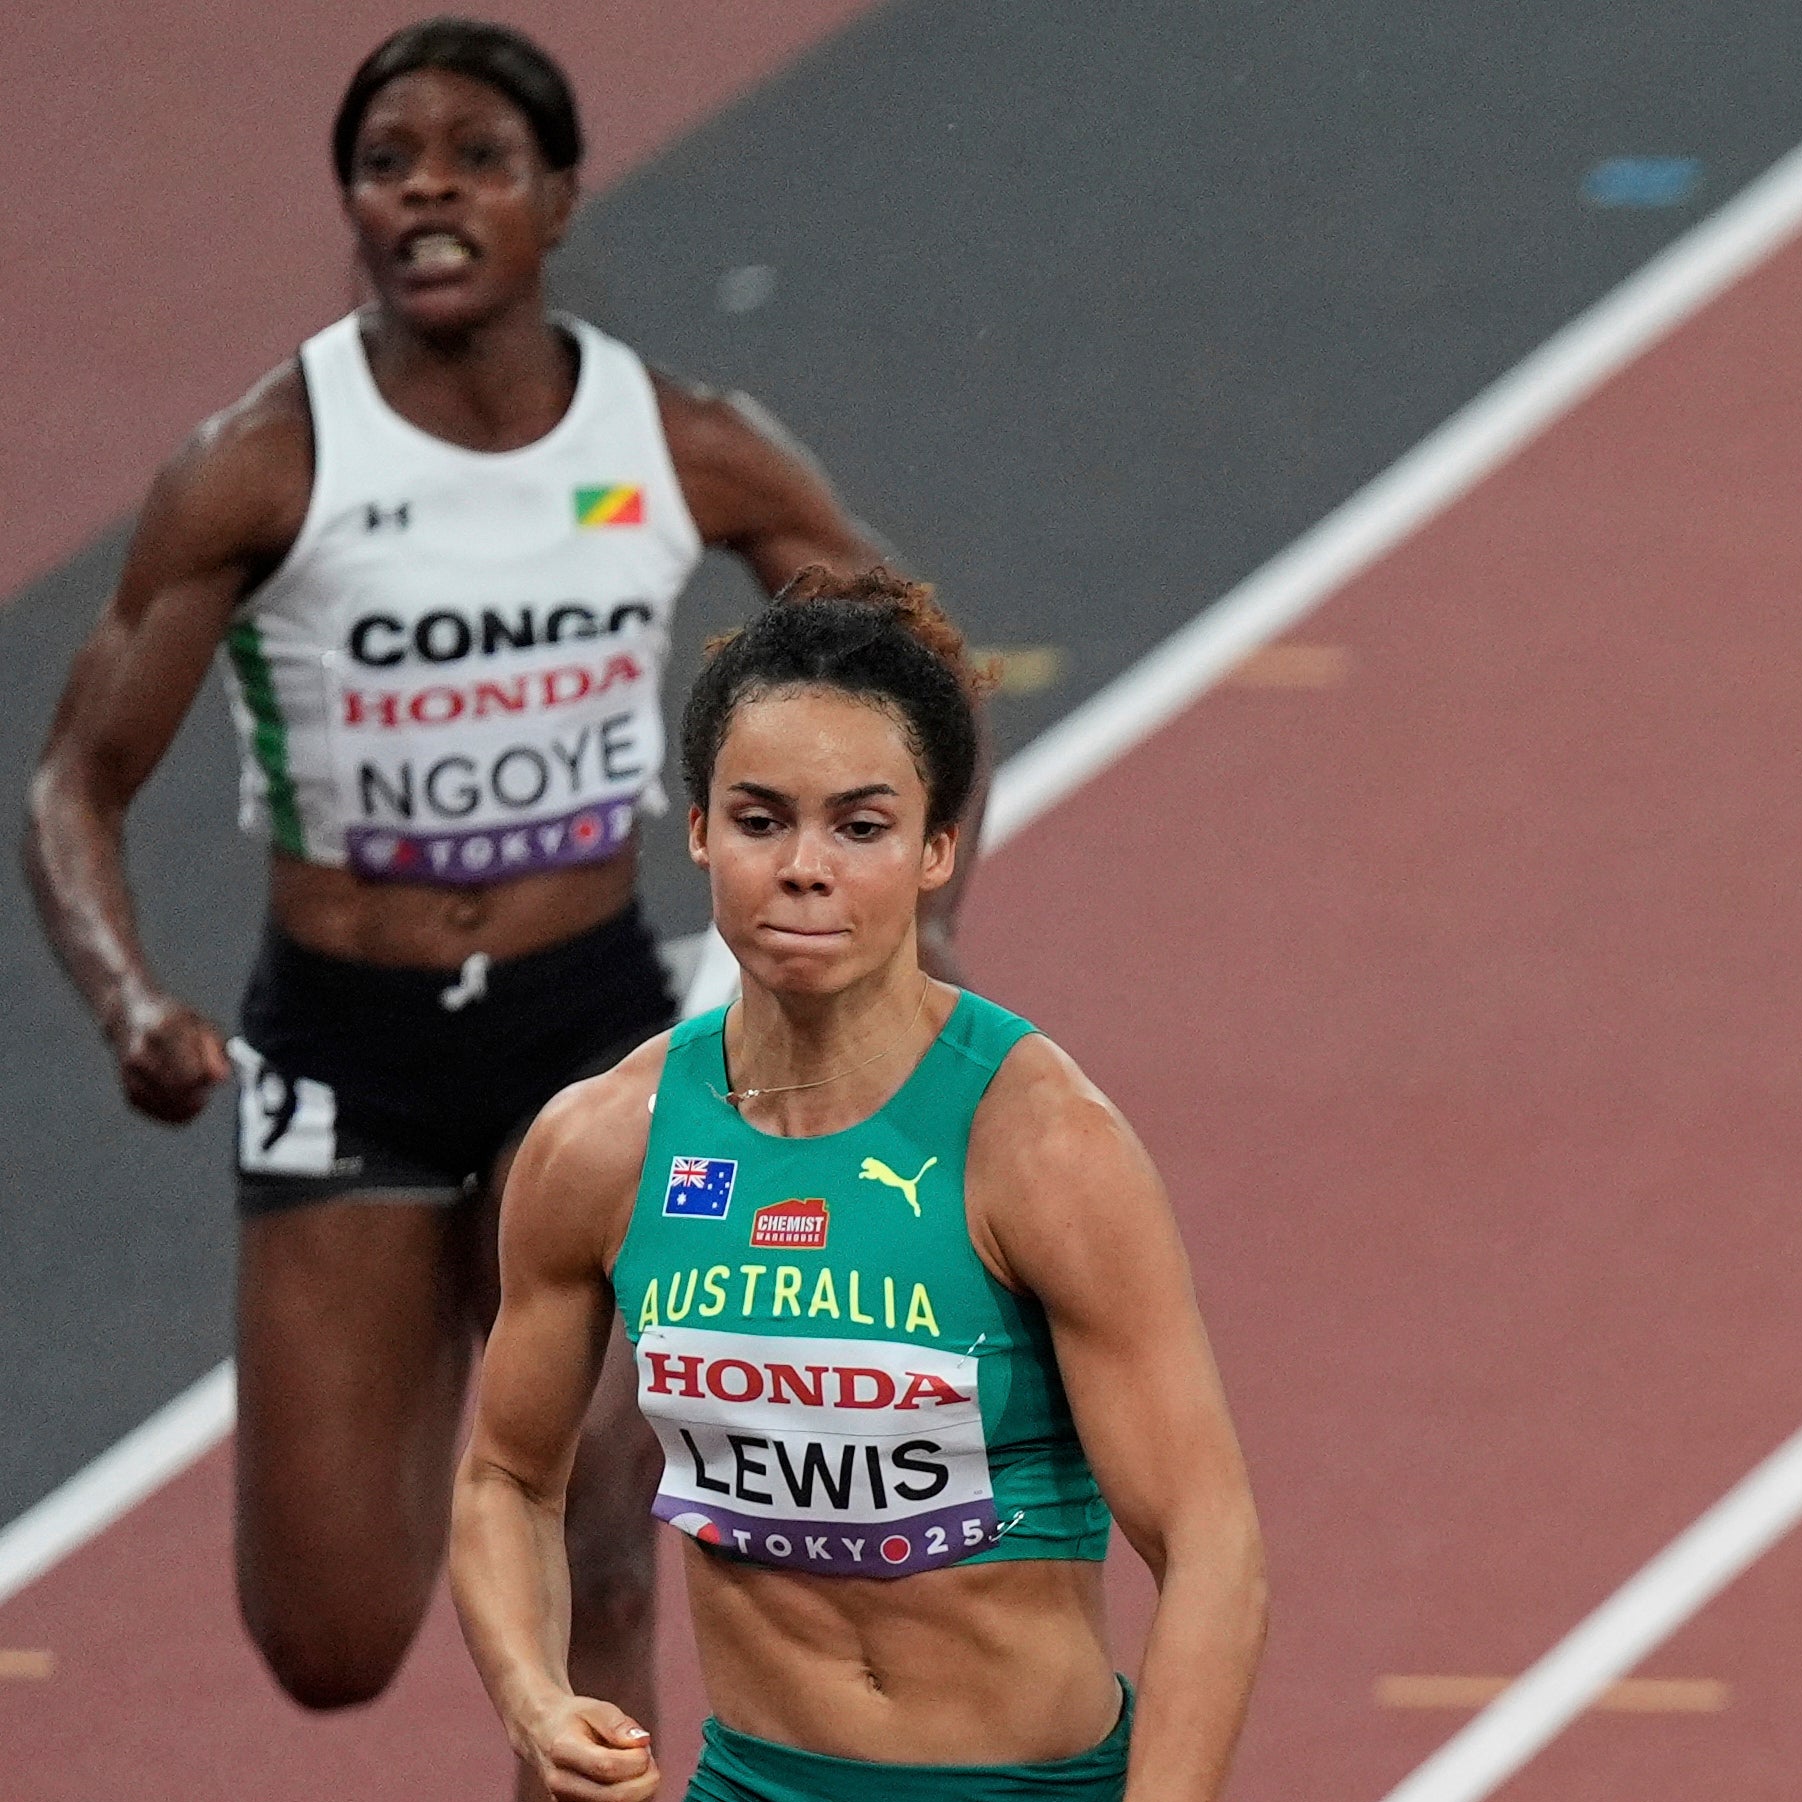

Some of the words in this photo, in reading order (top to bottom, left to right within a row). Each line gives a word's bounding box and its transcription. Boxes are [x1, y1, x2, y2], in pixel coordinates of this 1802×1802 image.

[344, 654, 643, 728] HONDA
[358, 710, 643, 819] NGOYE
[755, 1231, 821, 1243] WAREHOUSE
[757, 1214, 825, 1232] CHEMIST
[638, 1264, 941, 1338] AUSTRALIA
[644, 1351, 972, 1411] HONDA
[679, 1427, 950, 1511] LEWIS
